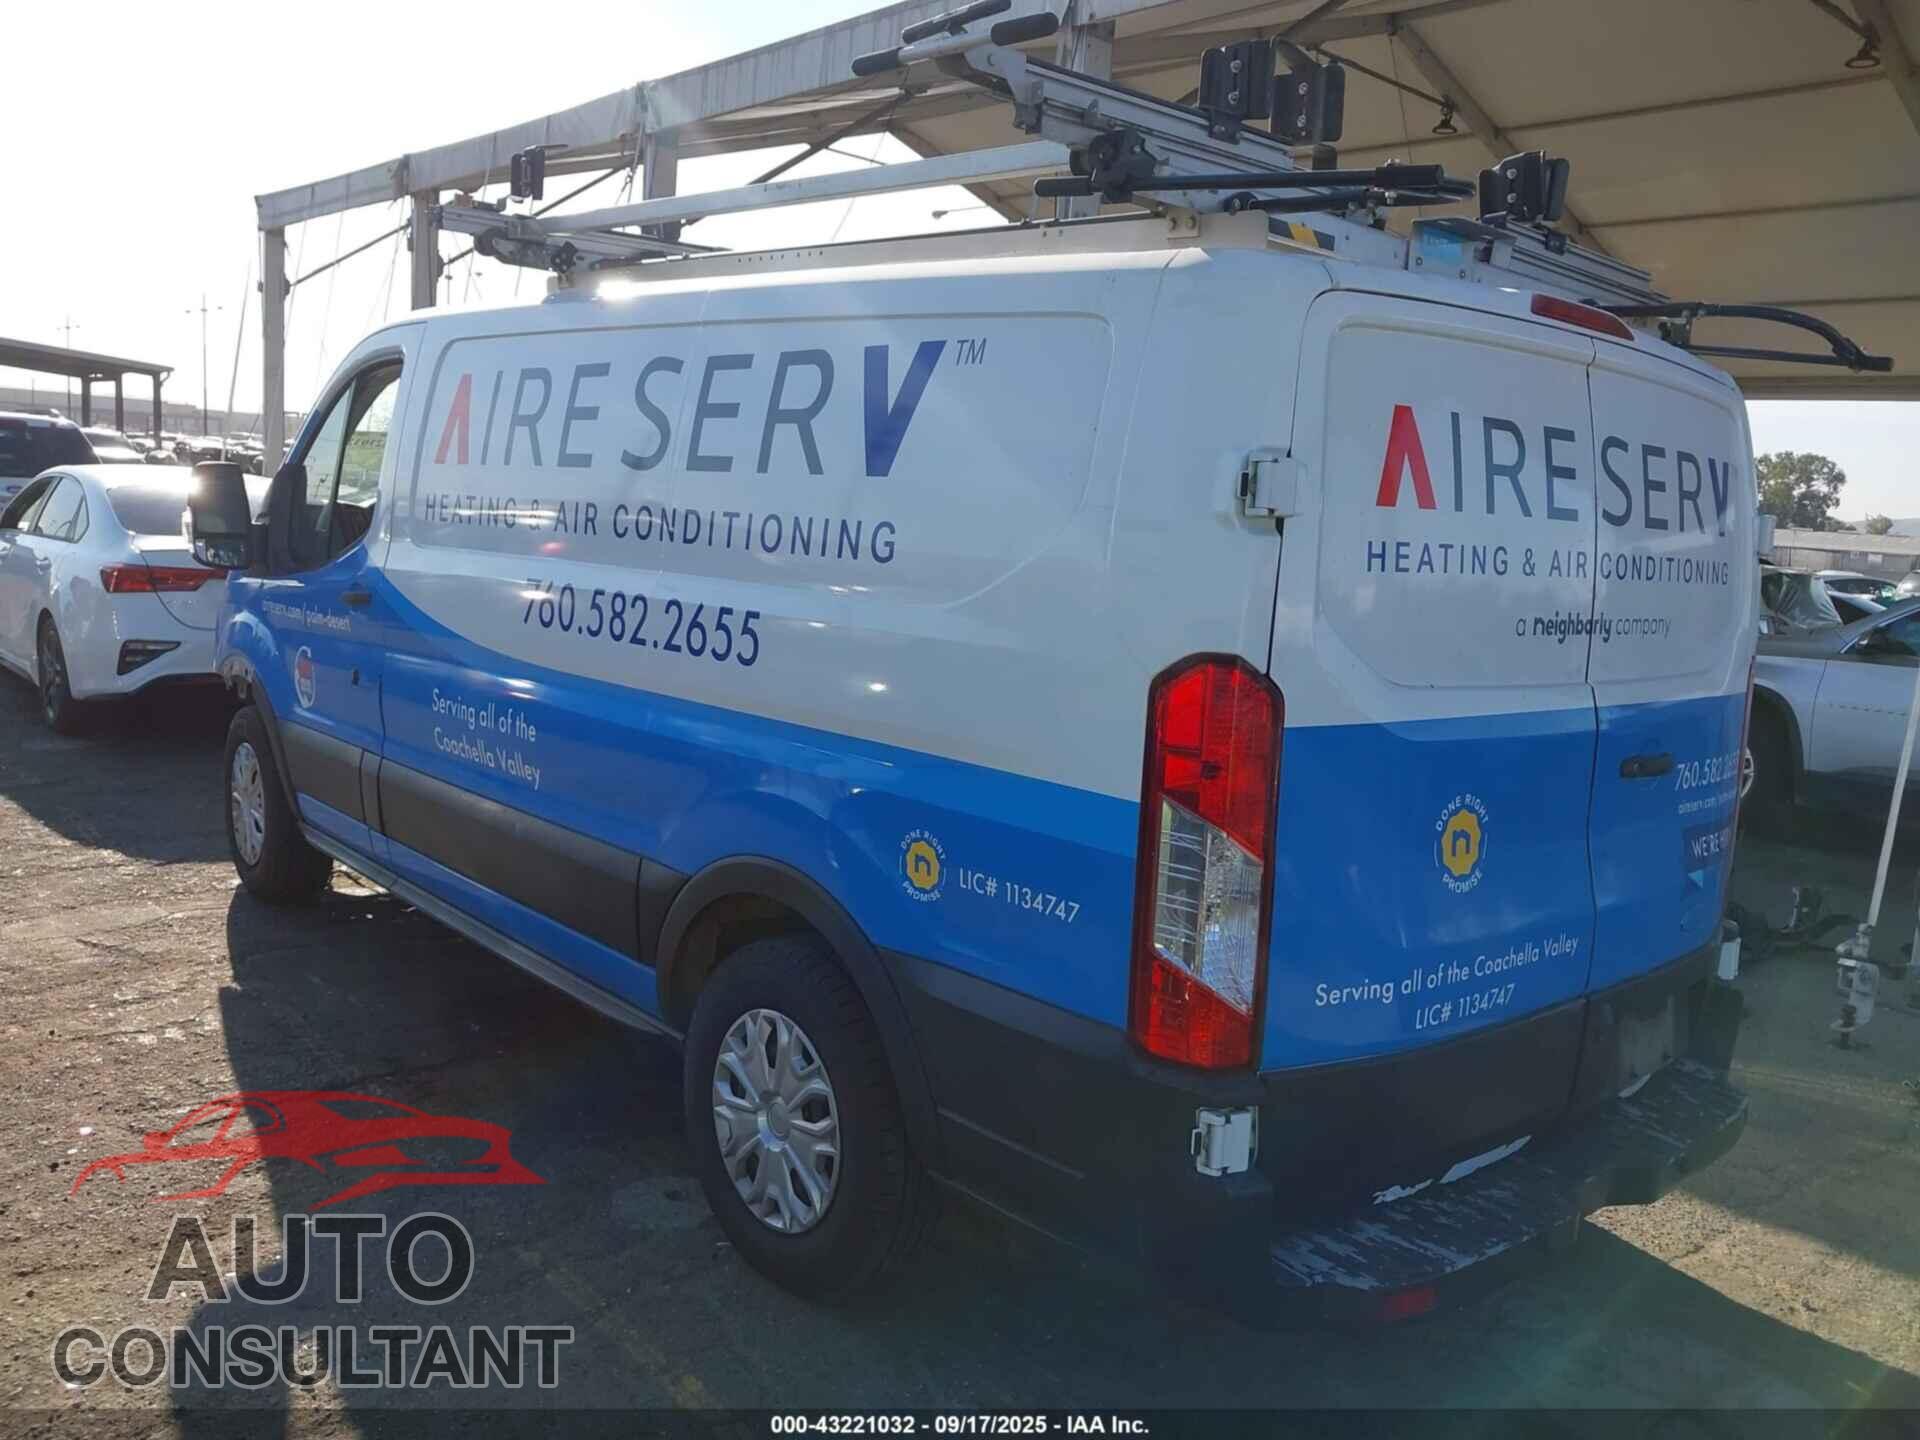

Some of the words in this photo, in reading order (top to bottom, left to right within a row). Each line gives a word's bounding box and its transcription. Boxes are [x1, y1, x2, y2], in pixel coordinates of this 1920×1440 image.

[434, 362, 611, 468] AIRE
[955, 338, 987, 366] TM
[1375, 404, 1579, 522] AIRE
[1600, 436, 1730, 537] SERV
[424, 493, 517, 529] HEATING
[554, 501, 598, 535] AIR
[612, 504, 897, 564] CONDITIONING
[1367, 540, 1508, 576] HEATING
[1522, 549, 1536, 577] &
[1549, 551, 1588, 579] AIR
[1600, 552, 1730, 586] CONDITIONING
[522, 578, 761, 667] 760.582.2655
[1516, 620, 1527, 636] a
[1532, 611, 1612, 645] neighborly
[1615, 615, 1671, 640] company
[432, 688, 476, 731] Serving
[479, 706, 496, 731] all
[499, 708, 514, 734] of
[515, 712, 537, 743] the
[434, 726, 495, 770] Coachella
[496, 747, 541, 792] Valley
[1435, 795, 1463, 832] DONE
[1465, 793, 1489, 825] RIGHT
[959, 867, 998, 897] LIC#
[1006, 882, 1081, 923] 1134747
[1442, 869, 1483, 894] PROMISE
[1314, 979, 1394, 1008] Serving
[1400, 969, 1423, 996] all
[1427, 967, 1445, 988] of
[1447, 962, 1471, 985] the
[1474, 947, 1540, 977] Coachella
[1543, 935, 1579, 962] Valley
[1415, 1002, 1452, 1031] LIC#
[1457, 984, 1515, 1018] 1134747
